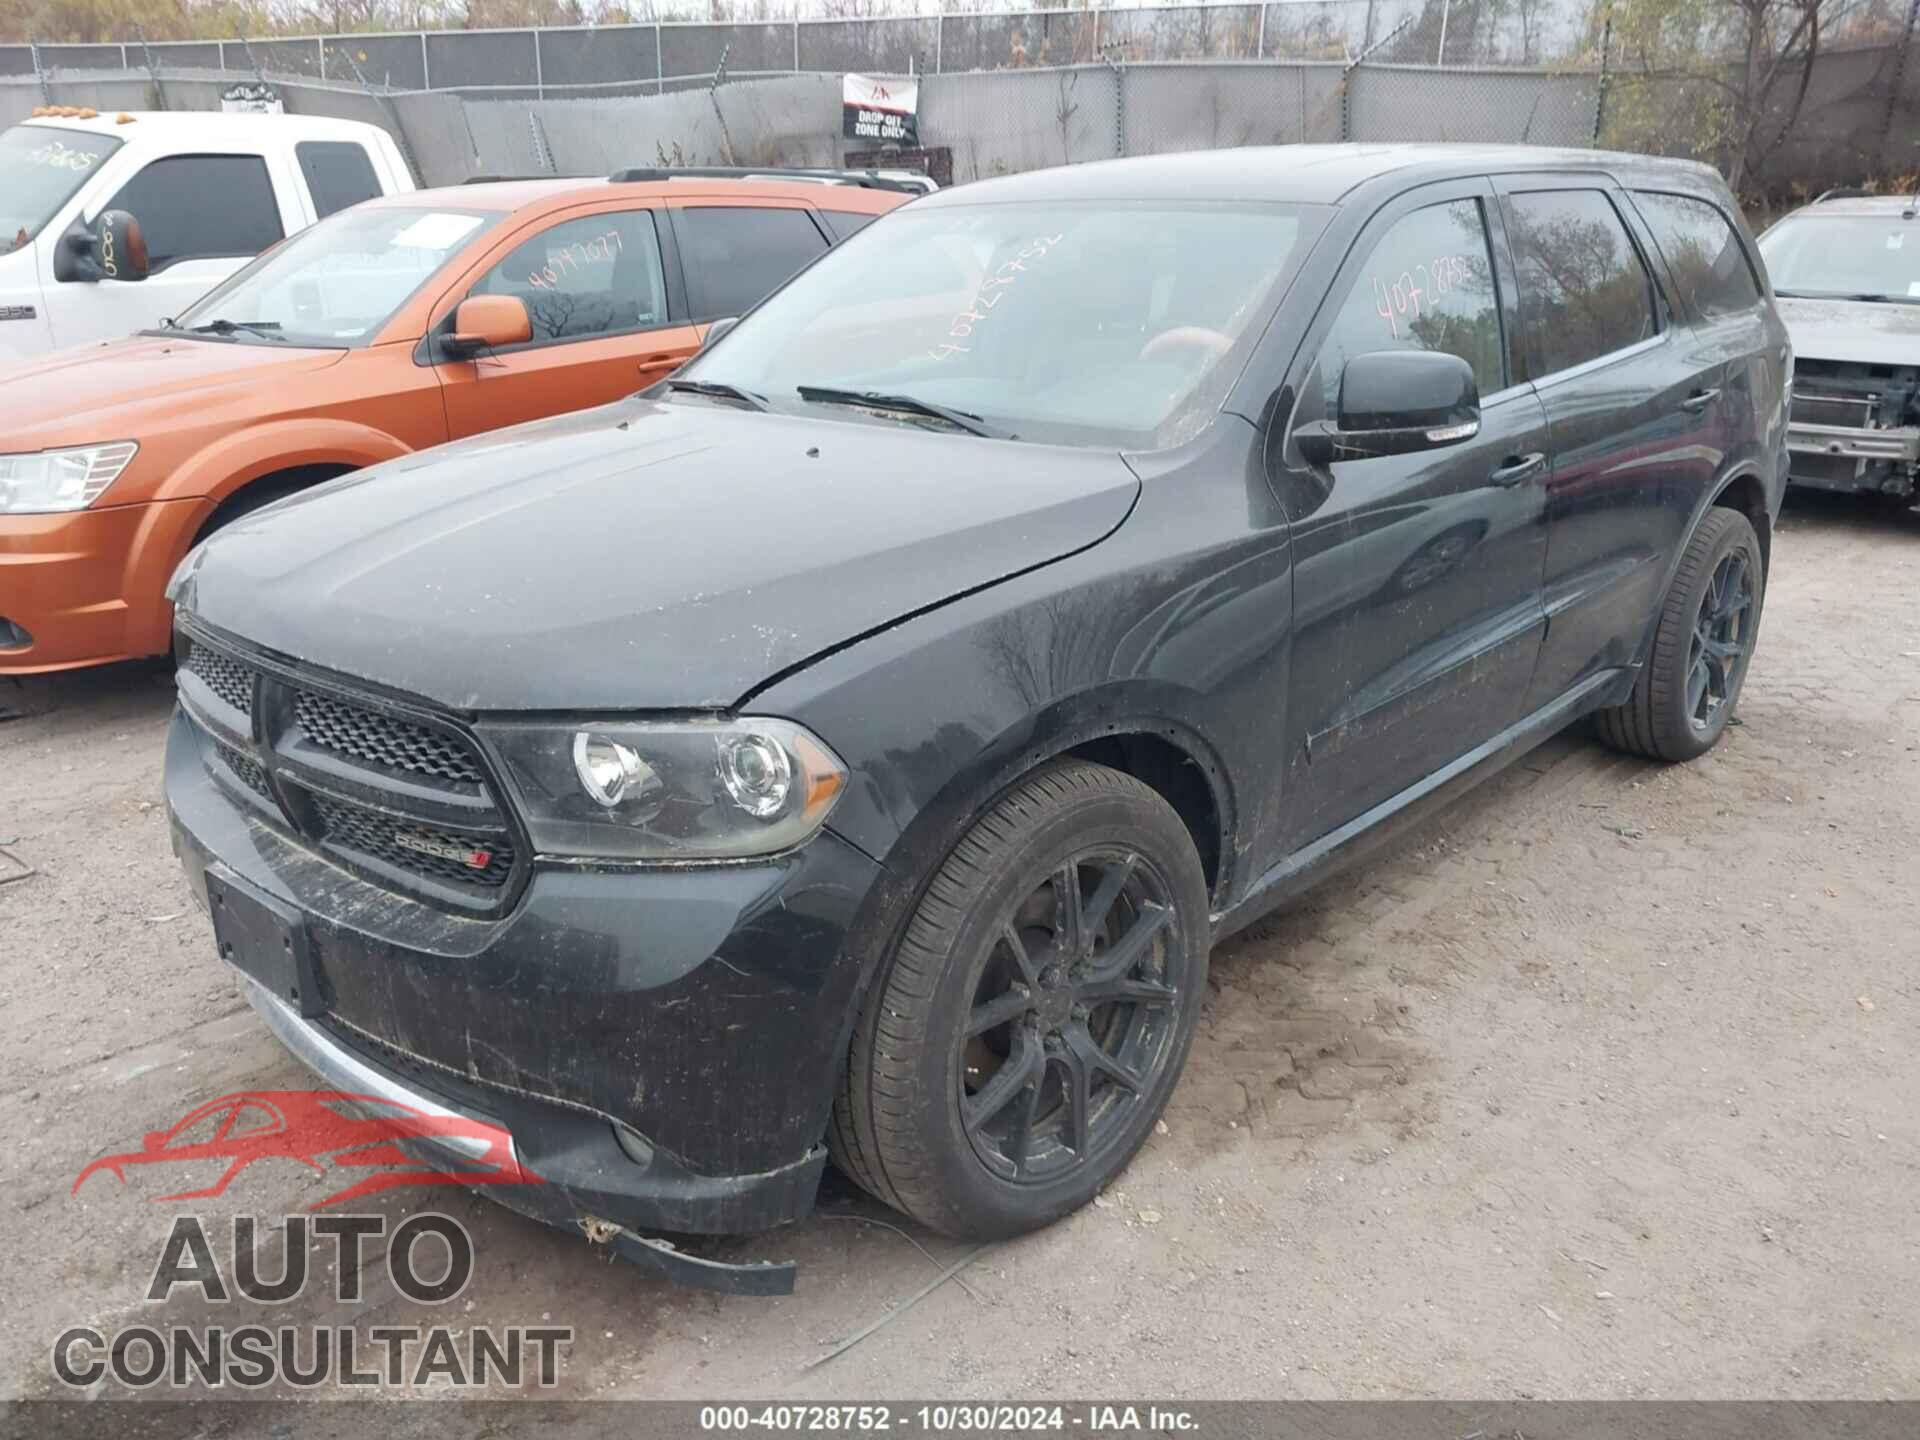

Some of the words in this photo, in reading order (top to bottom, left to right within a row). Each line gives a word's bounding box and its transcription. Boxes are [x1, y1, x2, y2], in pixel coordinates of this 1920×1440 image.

[858, 109, 884, 125] DROP
[855, 122, 880, 137] ZONE
[881, 124, 906, 139] ONLY
